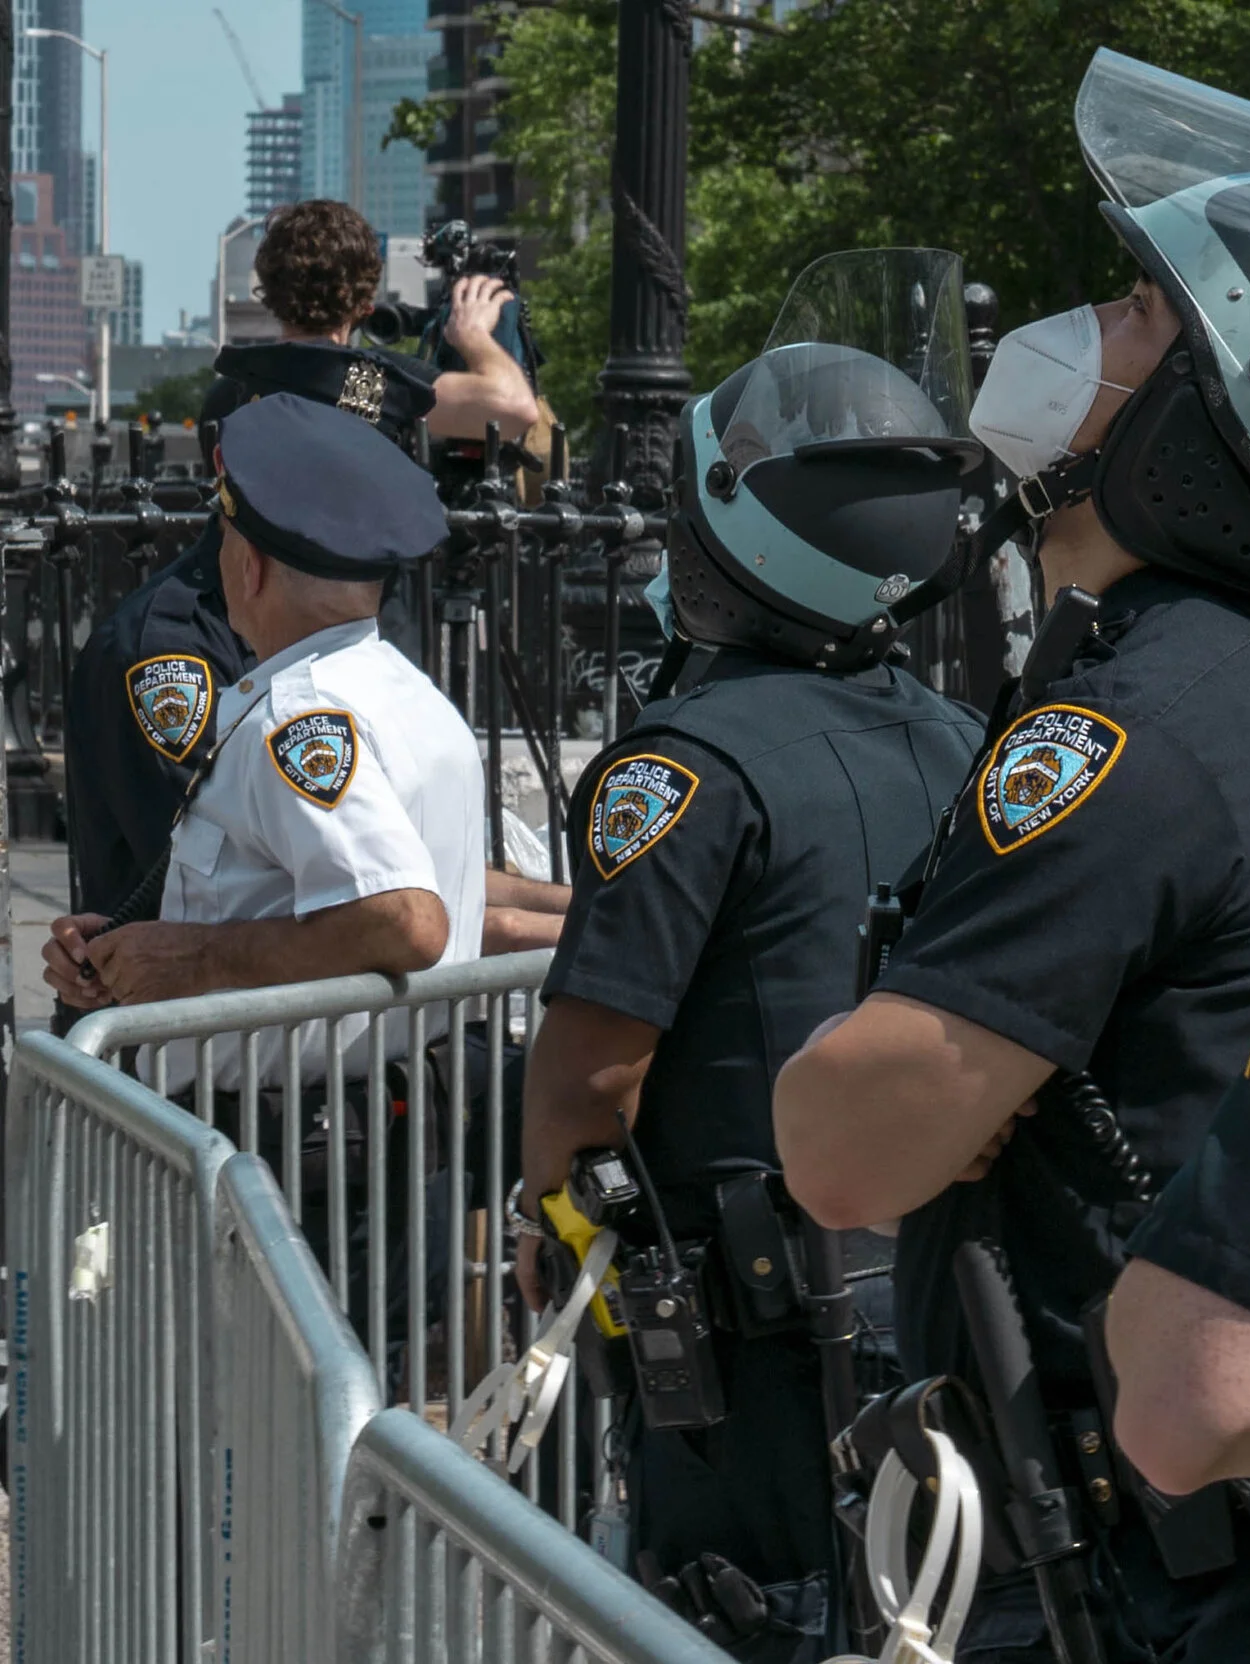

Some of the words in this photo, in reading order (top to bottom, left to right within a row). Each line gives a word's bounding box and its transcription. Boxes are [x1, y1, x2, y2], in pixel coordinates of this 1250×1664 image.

[144, 661, 186, 677] POLICE
[134, 672, 203, 696] DEPARTMENT
[137, 708, 153, 731] CITY
[152, 731, 167, 745] OF
[181, 723, 198, 746] NEW
[194, 691, 208, 721] YORK
[287, 716, 330, 736] POLICE
[1032, 713, 1093, 735] POLICE
[277, 725, 347, 756] DEPARTMENT
[1004, 727, 1107, 760] DEPARTMENT
[284, 764, 303, 783] CITY
[304, 781, 319, 792] OF
[332, 769, 347, 790] NEW
[342, 743, 352, 769] YORK
[627, 762, 671, 782] POLICE
[605, 774, 681, 804] DEPARTMENT
[986, 766, 1000, 799] CITY
[989, 803, 1002, 823] OF
[1018, 806, 1053, 835] NEW
[1053, 769, 1095, 807] YORK
[594, 803, 603, 832] CITY
[594, 834, 604, 853] OF
[616, 840, 641, 863] NEW
[641, 811, 674, 842] YORK
